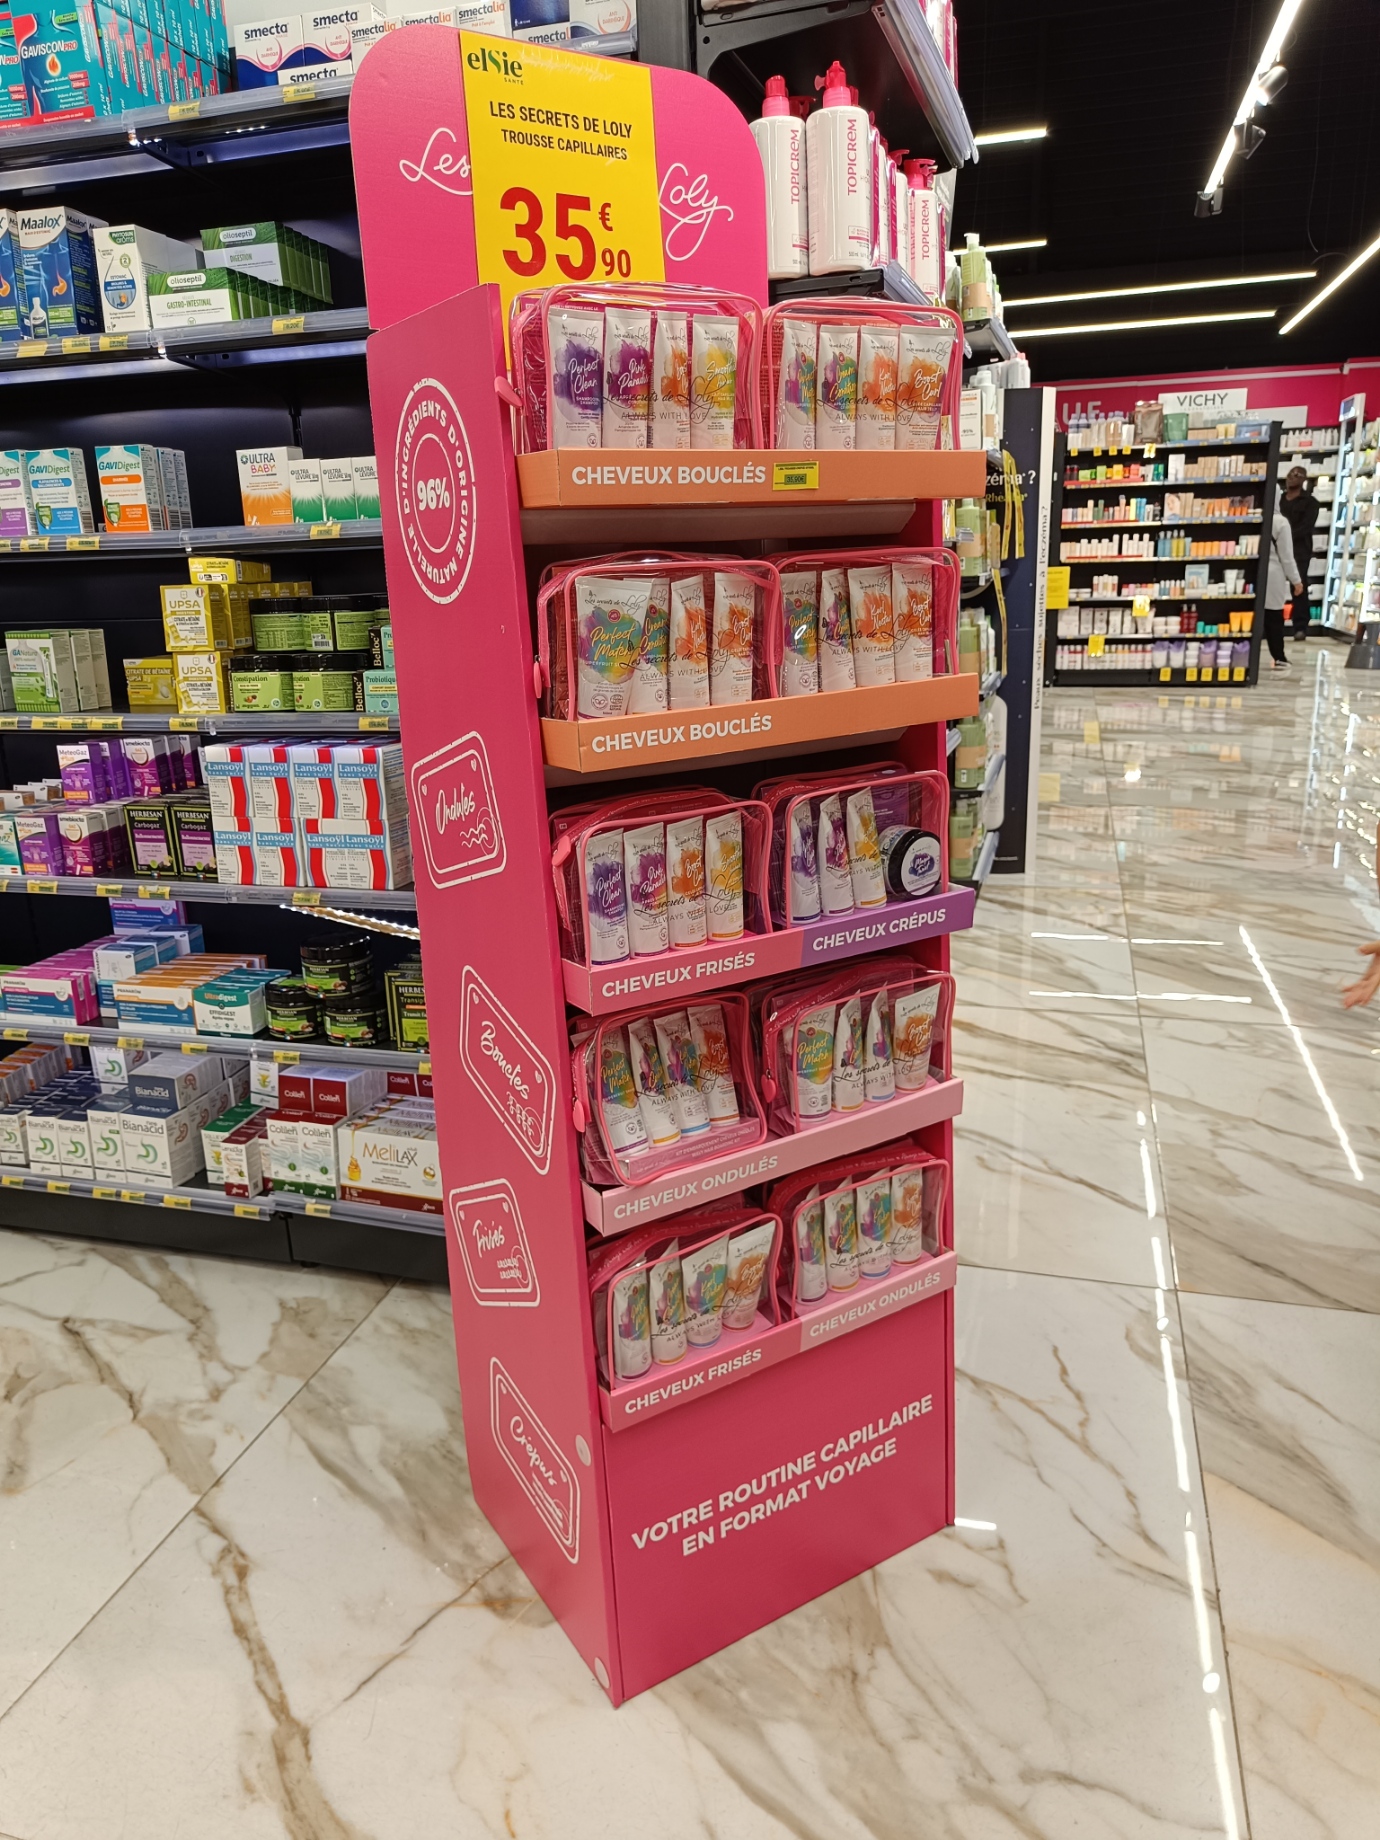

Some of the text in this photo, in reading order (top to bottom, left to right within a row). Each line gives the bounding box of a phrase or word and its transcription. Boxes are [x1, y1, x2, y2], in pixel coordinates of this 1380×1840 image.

[459, 1, 505, 18] smectalia
[313, 10, 359, 27] smecta
[244, 22, 289, 40] smecta
[352, 20, 397, 38] smectalia
[528, 24, 570, 44] smectal
[290, 67, 338, 83] smecta
[490, 101, 632, 139] LES SECRETS DE LOLY
[501, 128, 628, 161] TROUSSE CAPILLAIRES
[399, 127, 474, 196] Les
[657, 162, 734, 262] Loly
[20, 214, 62, 231] Maalox
[222, 229, 253, 241] olioseptil
[230, 253, 253, 263] DIGESTION
[170, 275, 203, 287] olioseptil
[1177, 392, 1229, 408] VICHY
[660, 411, 681, 420] WITH
[1062, 401, 1102, 425] UE
[98, 461, 141, 473] GAVIDigest
[249, 453, 275, 464] ULTRA
[0, 466, 20, 476] Digest
[29, 464, 71, 477] GAVIDigest
[250, 464, 275, 474] BABY
[571, 461, 766, 486] CHEVEUX BOUCLÉS
[417, 477, 450, 511] 96%
[169, 600, 200, 609] UPSA
[590, 623, 637, 647] Perfect
[181, 666, 213, 675] UPSA
[677, 669, 700, 677] WITH
[233, 675, 268, 684] Constipation
[365, 676, 396, 685] Probiotiqu
[591, 712, 772, 754] CHEVEUX BOUCLÉS
[130, 810, 163, 818] HERBESAN
[177, 811, 210, 819] HERBESAN
[435, 782, 476, 835] Ondulés
[134, 821, 160, 829] Carbogaz
[181, 822, 207, 830] Carbogaz
[812, 908, 946, 952] CHEVEUX CRÉPUS
[602, 951, 756, 998] CHEVEUX FRISÉS
[399, 986, 426, 994] HERBES
[479, 1020, 530, 1100] Bouclés
[122, 1120, 164, 1134] Bianacid
[269, 1124, 298, 1135] Colilen
[302, 1126, 331, 1138] Colilen
[363, 1142, 418, 1167] MeliLAX
[613, 1155, 778, 1220] CHEVEUX ONDULÉS
[472, 1219, 505, 1257] Frisés
[809, 1272, 941, 1338] CHEVEUX ONDULÉS
[625, 1349, 762, 1415] CHEVEUX FRISÉS
[510, 1415, 557, 1487] Crépus
[631, 1393, 934, 1550] VOTRE ROUTINE CAPILLAIRE
[682, 1437, 897, 1557] EN FORMAT VOYAGE
